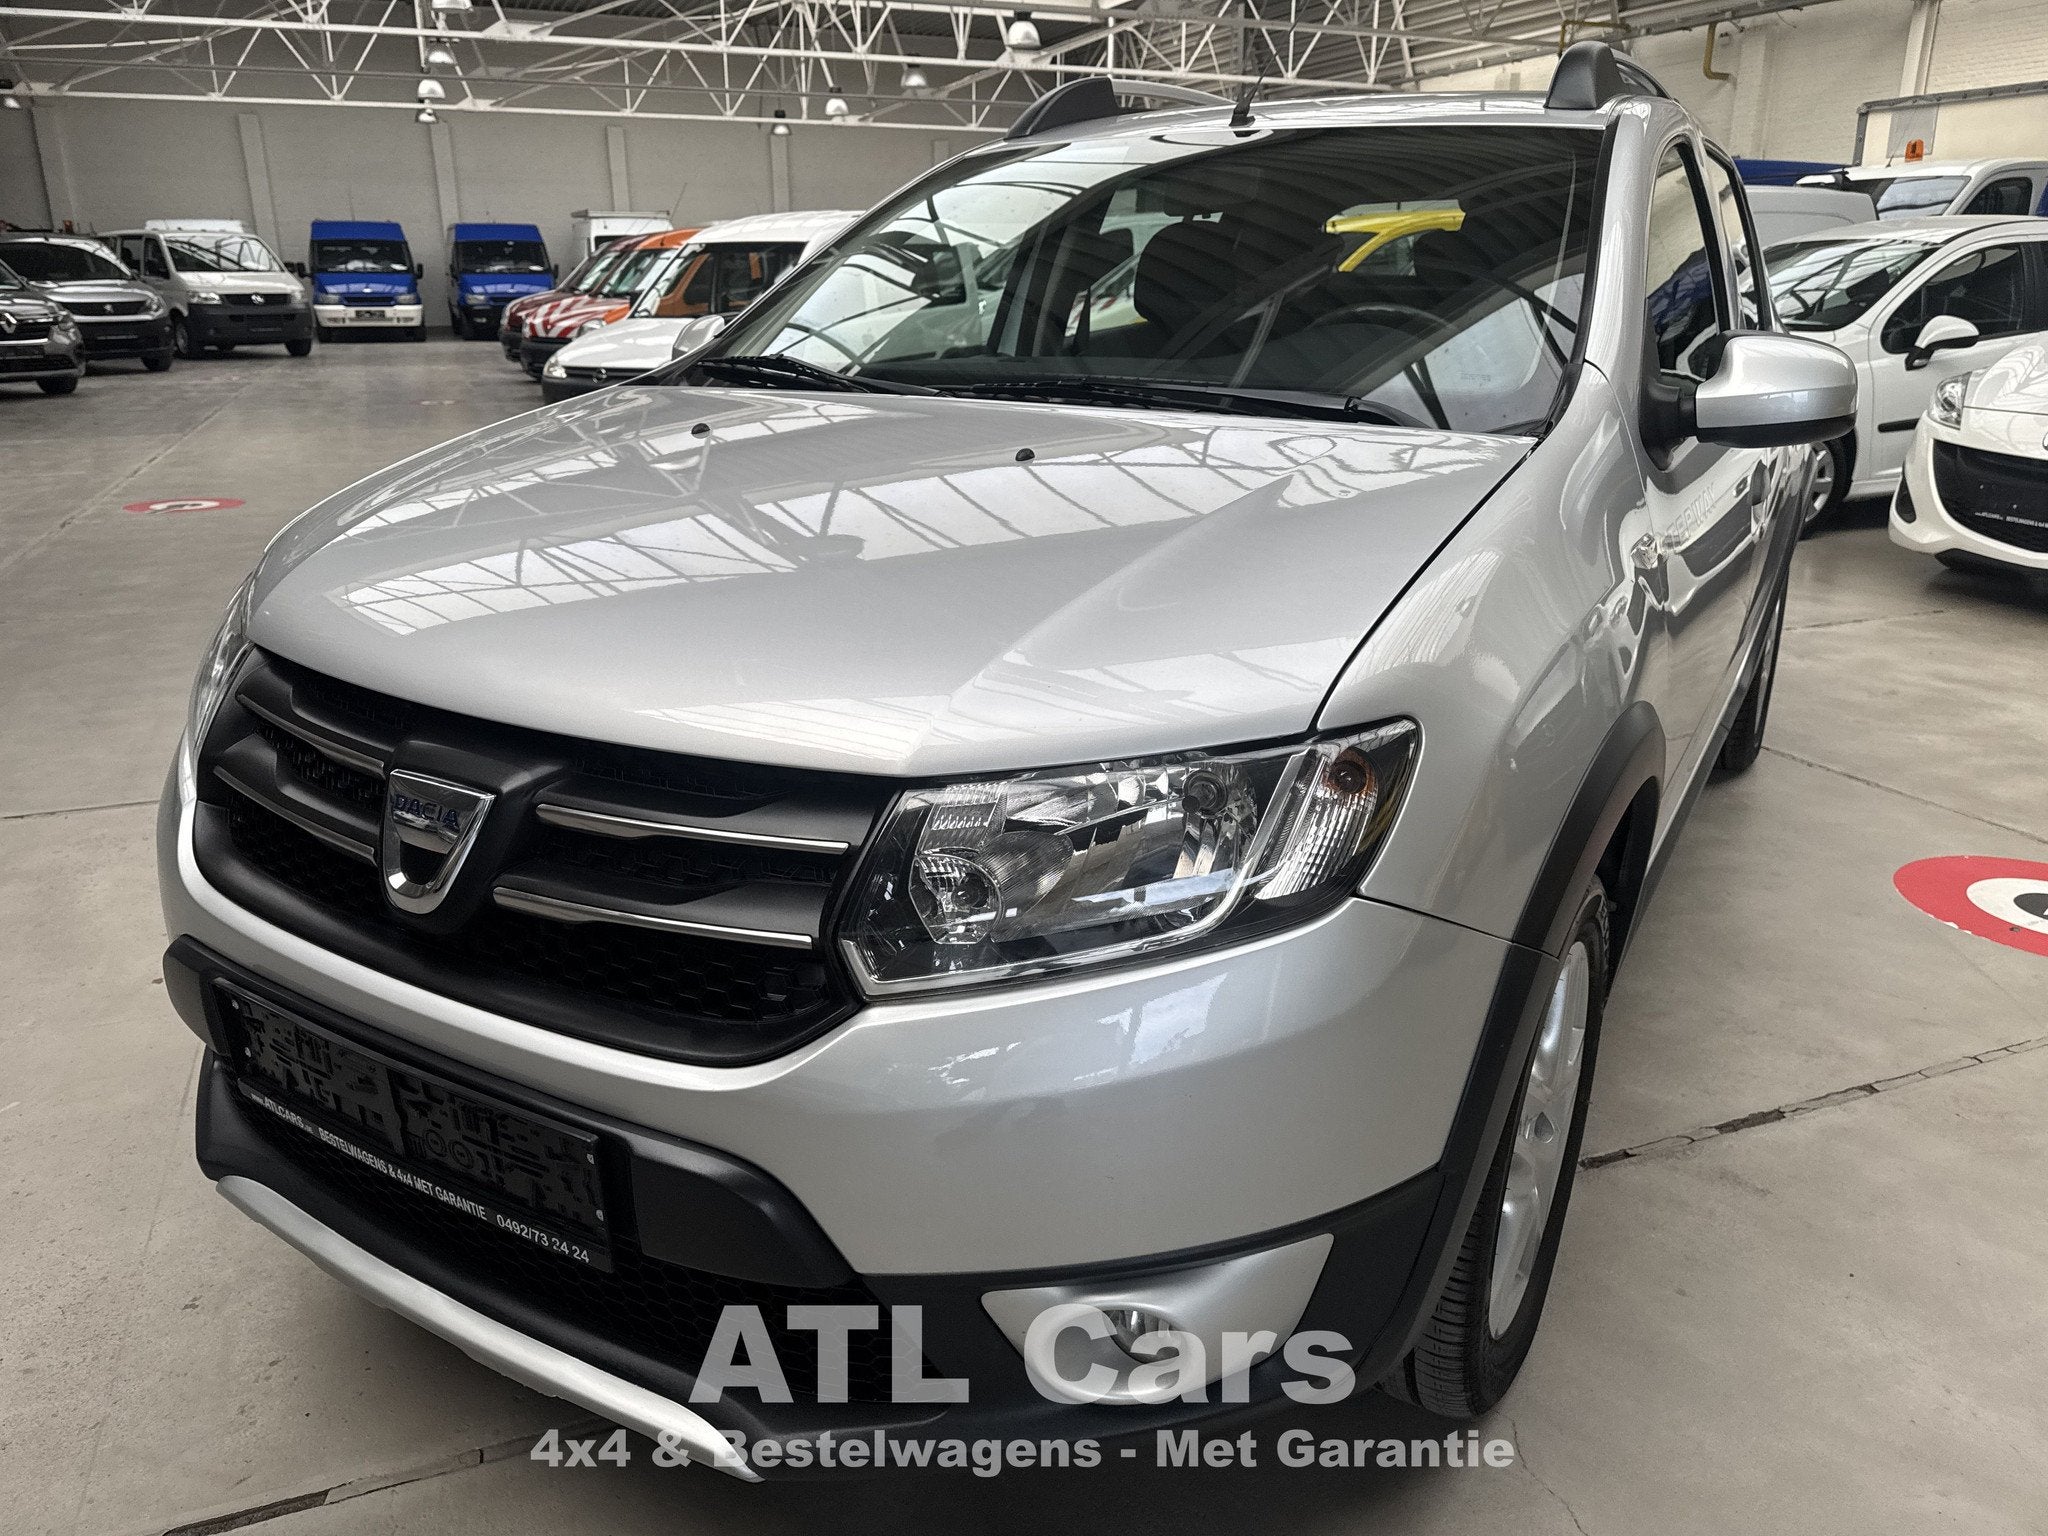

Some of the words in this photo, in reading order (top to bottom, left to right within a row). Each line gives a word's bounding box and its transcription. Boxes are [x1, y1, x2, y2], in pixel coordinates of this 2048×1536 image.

[392, 793, 461, 833] DACIA
[318, 1127, 388, 1174] BESTELWAGENS
[388, 1164, 397, 1179] &
[413, 1176, 434, 1196] MET
[435, 1186, 488, 1221] GARANTIE
[496, 1214, 549, 1247] 0492/73
[551, 1237, 570, 1255] 24
[571, 1245, 590, 1263] 24
